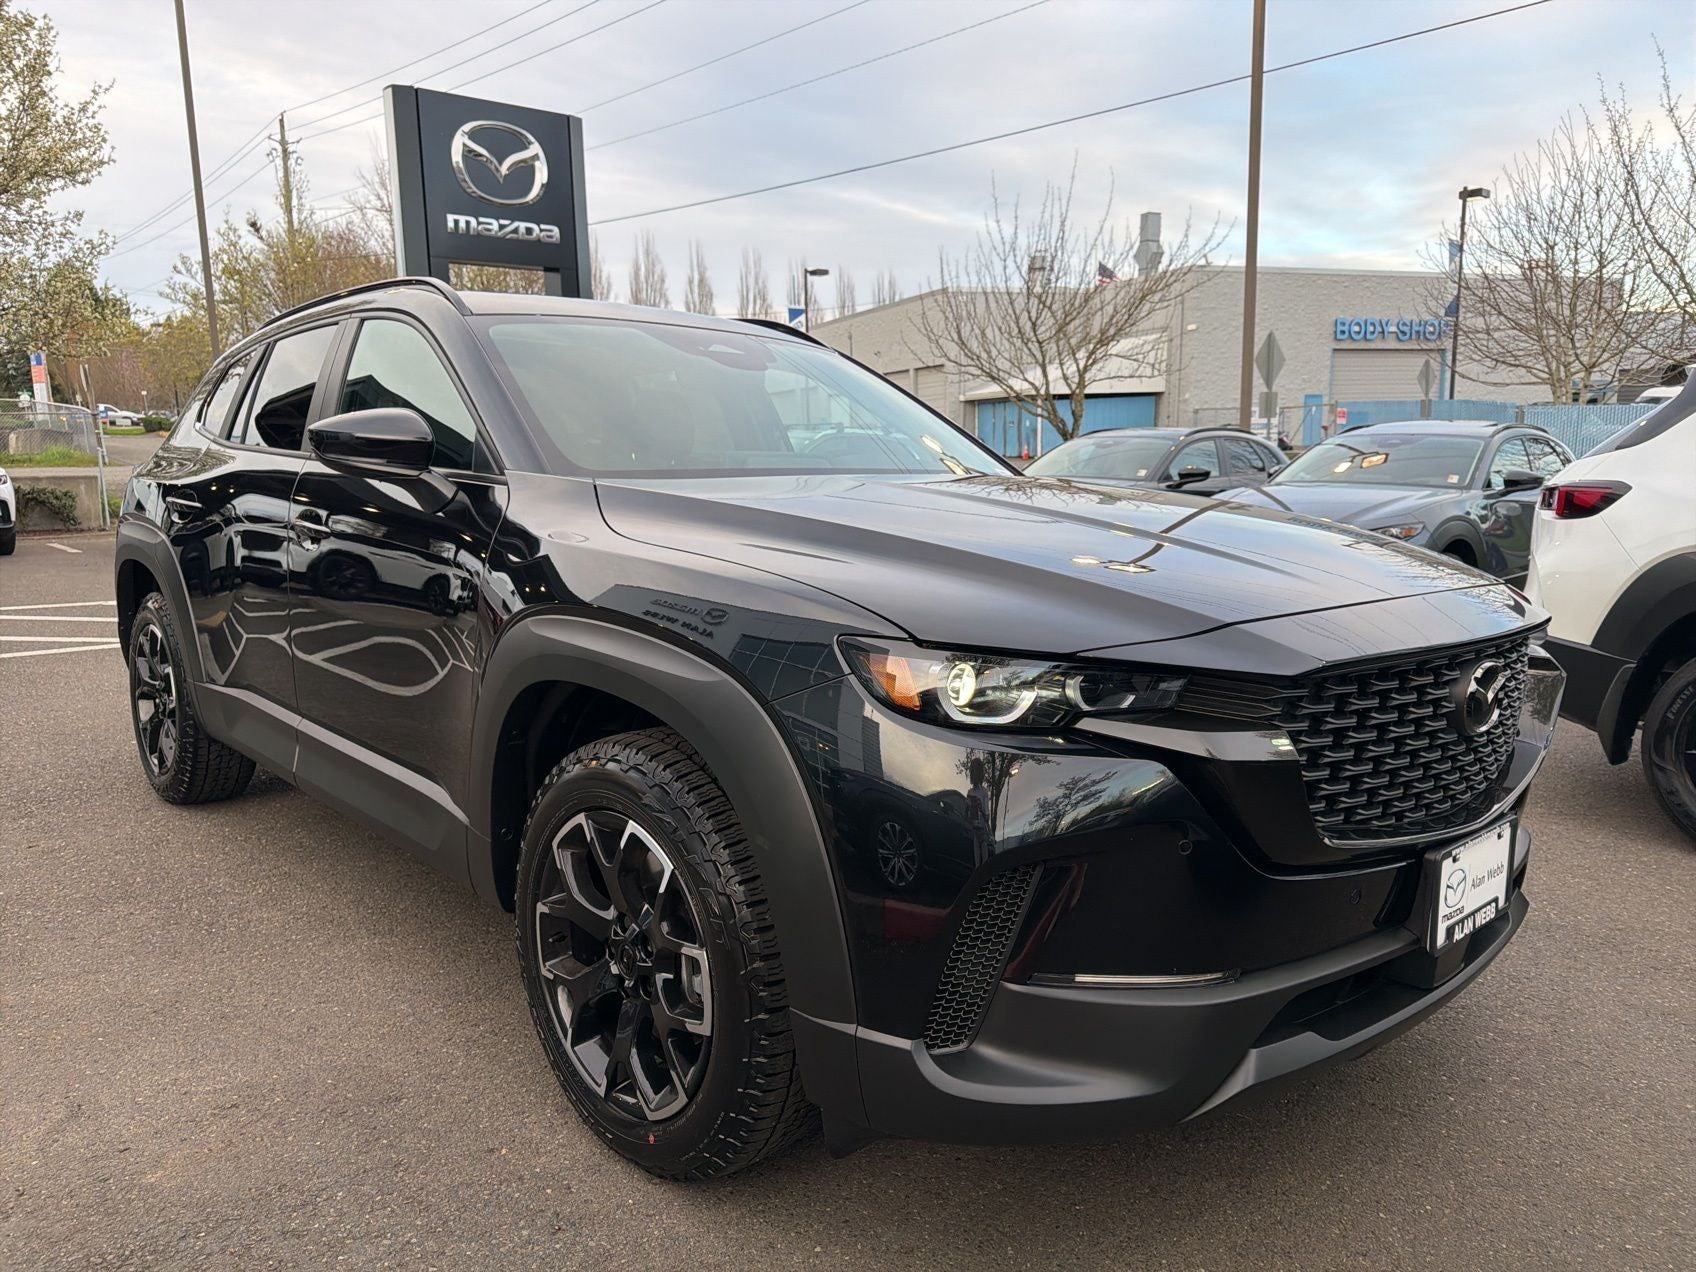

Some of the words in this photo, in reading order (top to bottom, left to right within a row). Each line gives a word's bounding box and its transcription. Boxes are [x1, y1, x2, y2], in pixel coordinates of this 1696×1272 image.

[446, 213, 561, 245] mazda
[1335, 317, 1391, 341] BODY
[1397, 318, 1452, 341] SHOP
[1470, 874, 1486, 891] Alan
[1487, 861, 1505, 880] Webb
[1441, 905, 1465, 925] mazda
[1453, 914, 1474, 944] ALAN
[1474, 901, 1496, 929] WEBB
